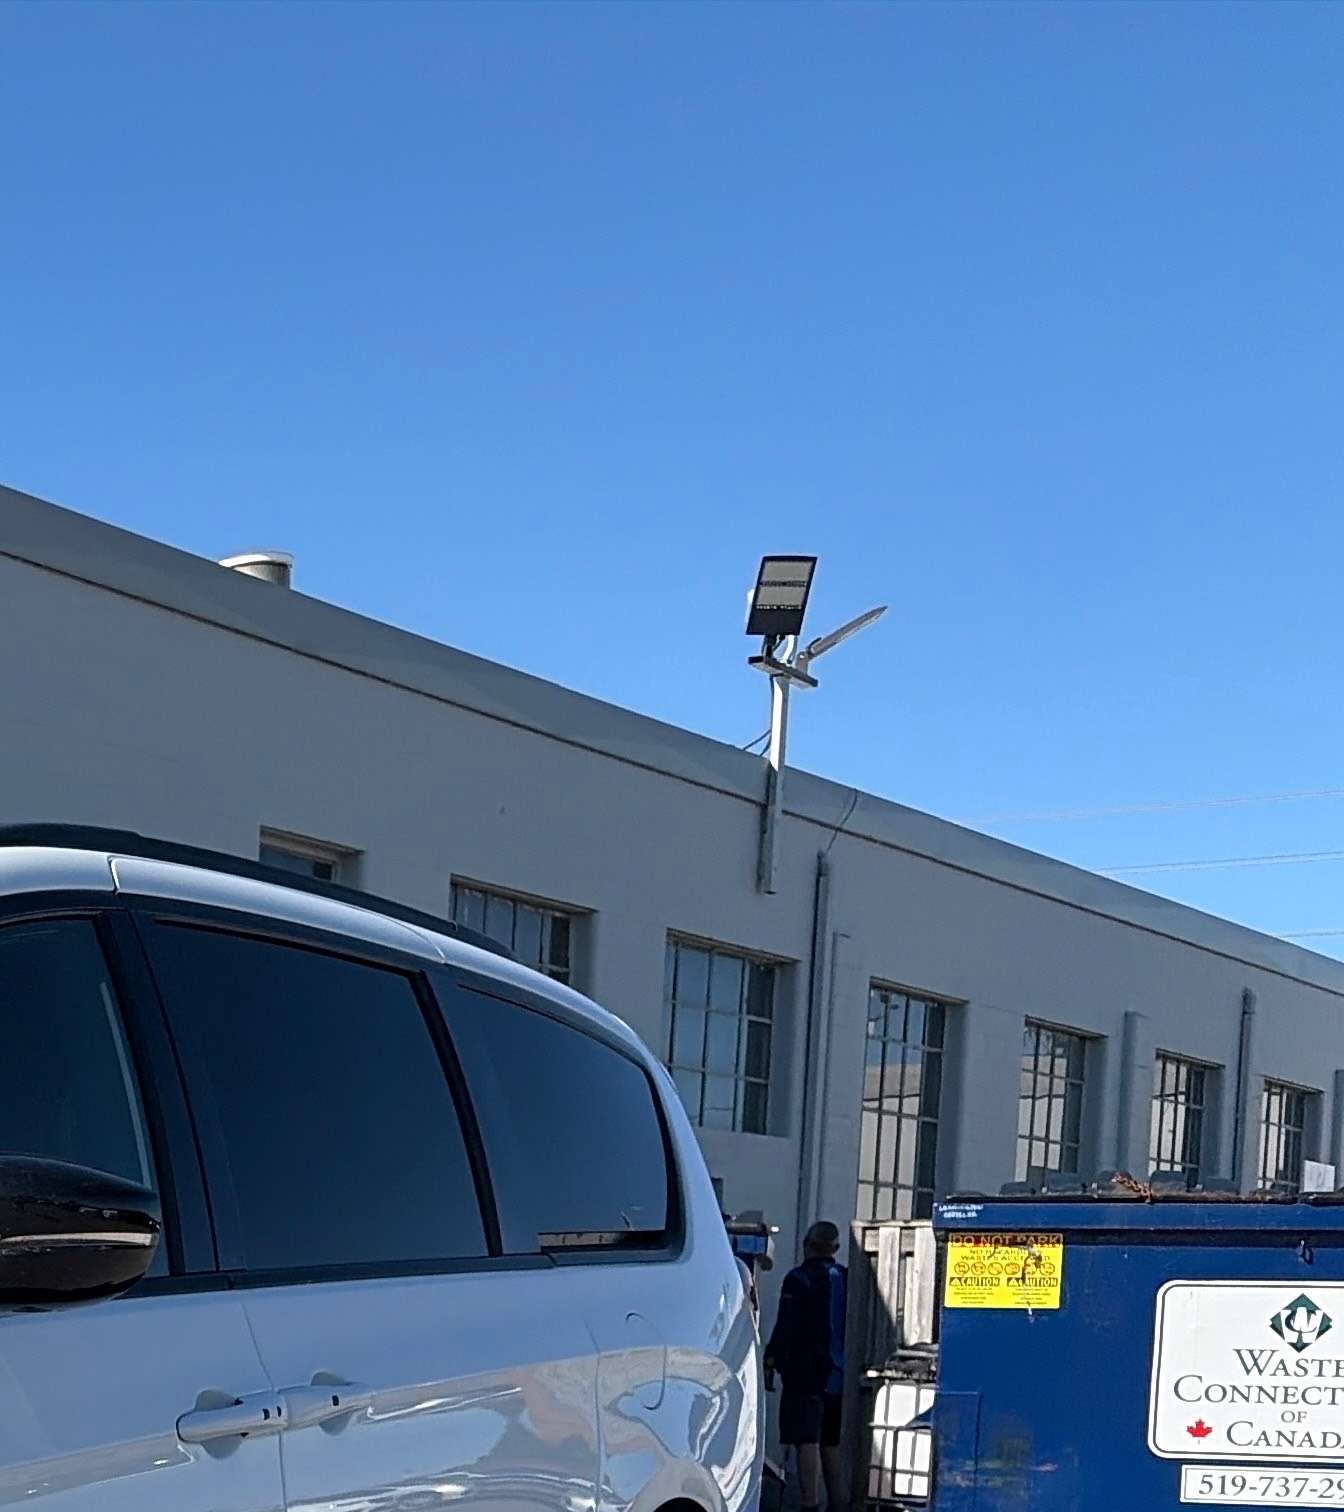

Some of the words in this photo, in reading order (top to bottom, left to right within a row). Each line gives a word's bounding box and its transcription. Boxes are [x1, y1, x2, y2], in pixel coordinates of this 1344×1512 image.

[953, 1235, 974, 1246] DO
[980, 1235, 1010, 1246] NOT
[1017, 1235, 1059, 1247] PARK
[962, 1277, 999, 1287] CAUTION
[1232, 1348, 1344, 1378] WASTE
[1280, 1410, 1308, 1424] OF
[1226, 1420, 1344, 1449] CANAD
